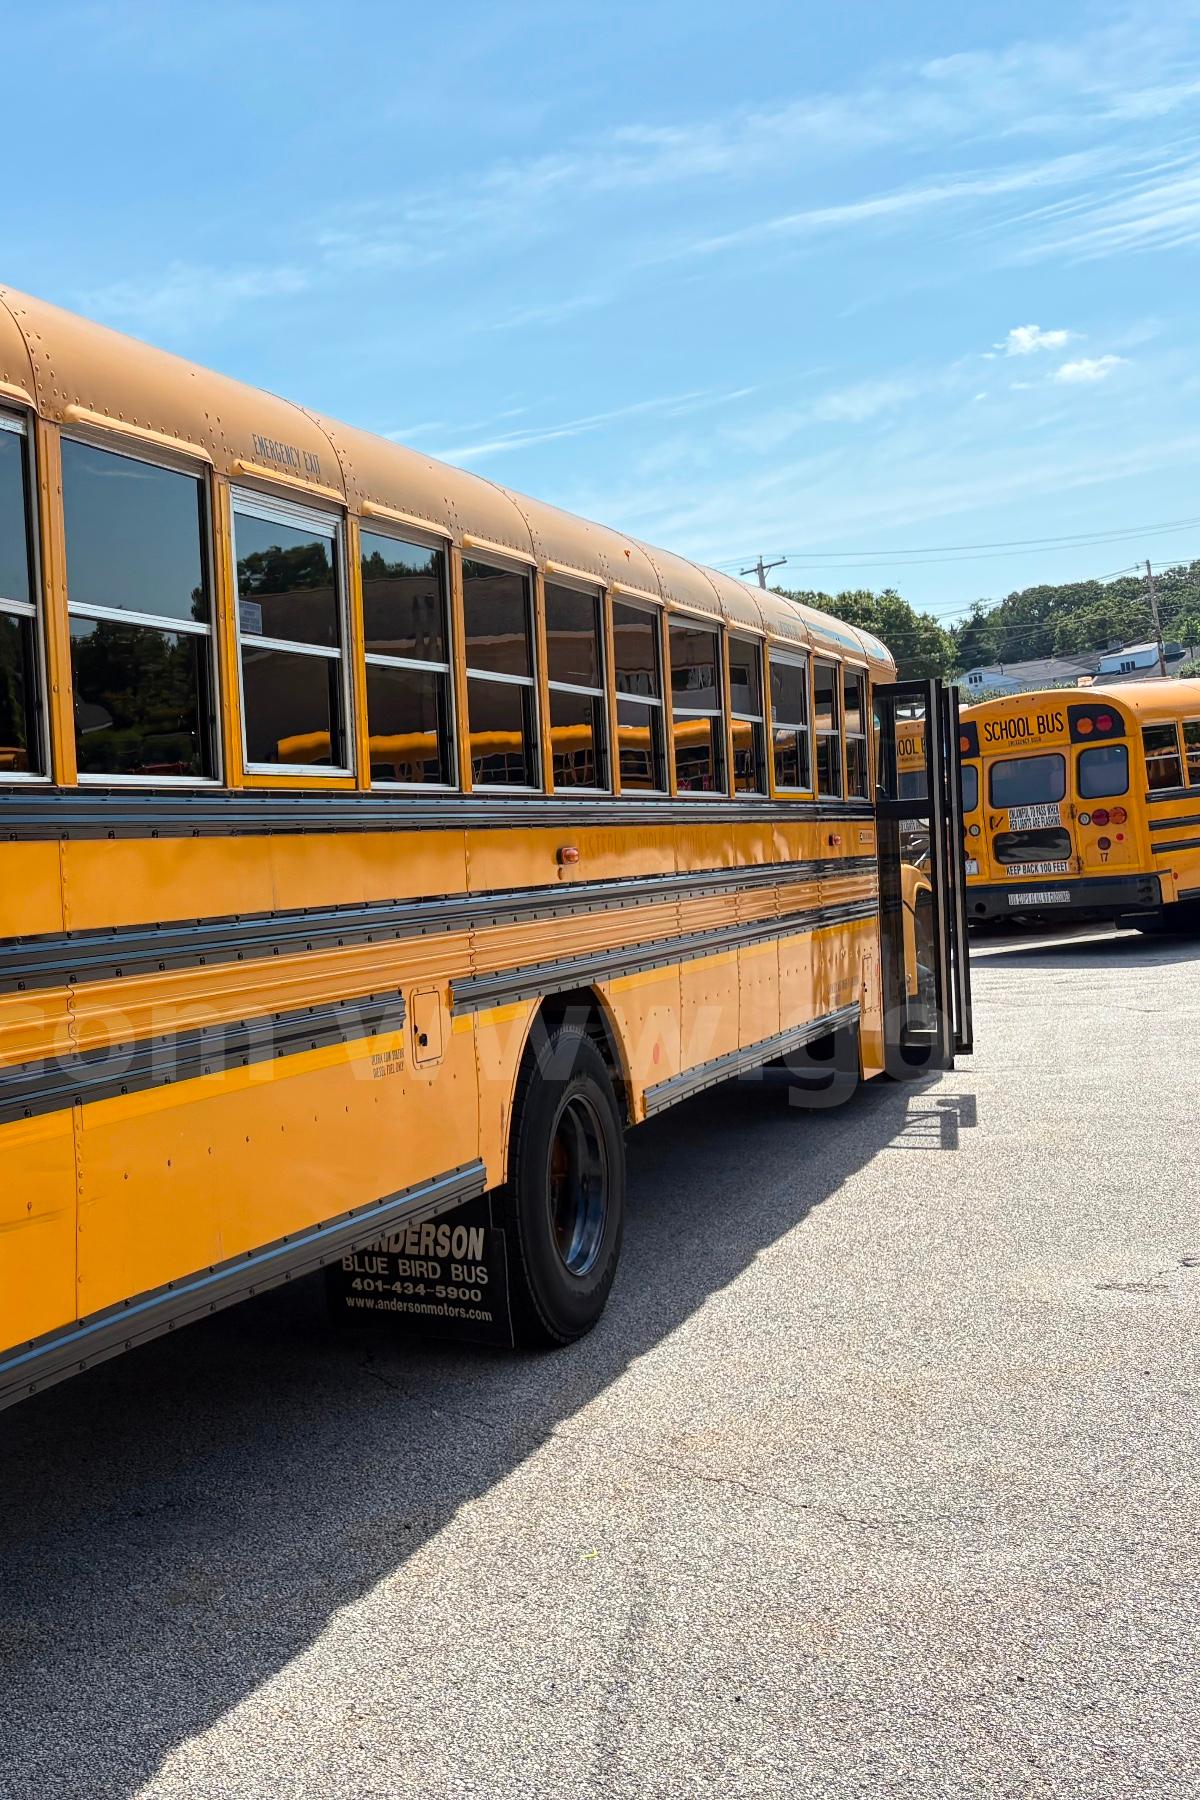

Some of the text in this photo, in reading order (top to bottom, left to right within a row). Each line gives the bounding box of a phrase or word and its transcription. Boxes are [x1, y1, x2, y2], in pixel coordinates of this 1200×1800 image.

[252, 433, 321, 475] EMERGENCY EXIT
[983, 711, 1064, 742] SCHOOL BUS
[897, 738, 919, 757] OOL
[1007, 862, 1067, 875] KEEP BACK 100 FEET
[342, 1255, 489, 1285] BLUE BIRD BUS
[351, 1277, 482, 1302] 401-434-5900
[345, 1295, 493, 1322] www.andersonmotors.com
